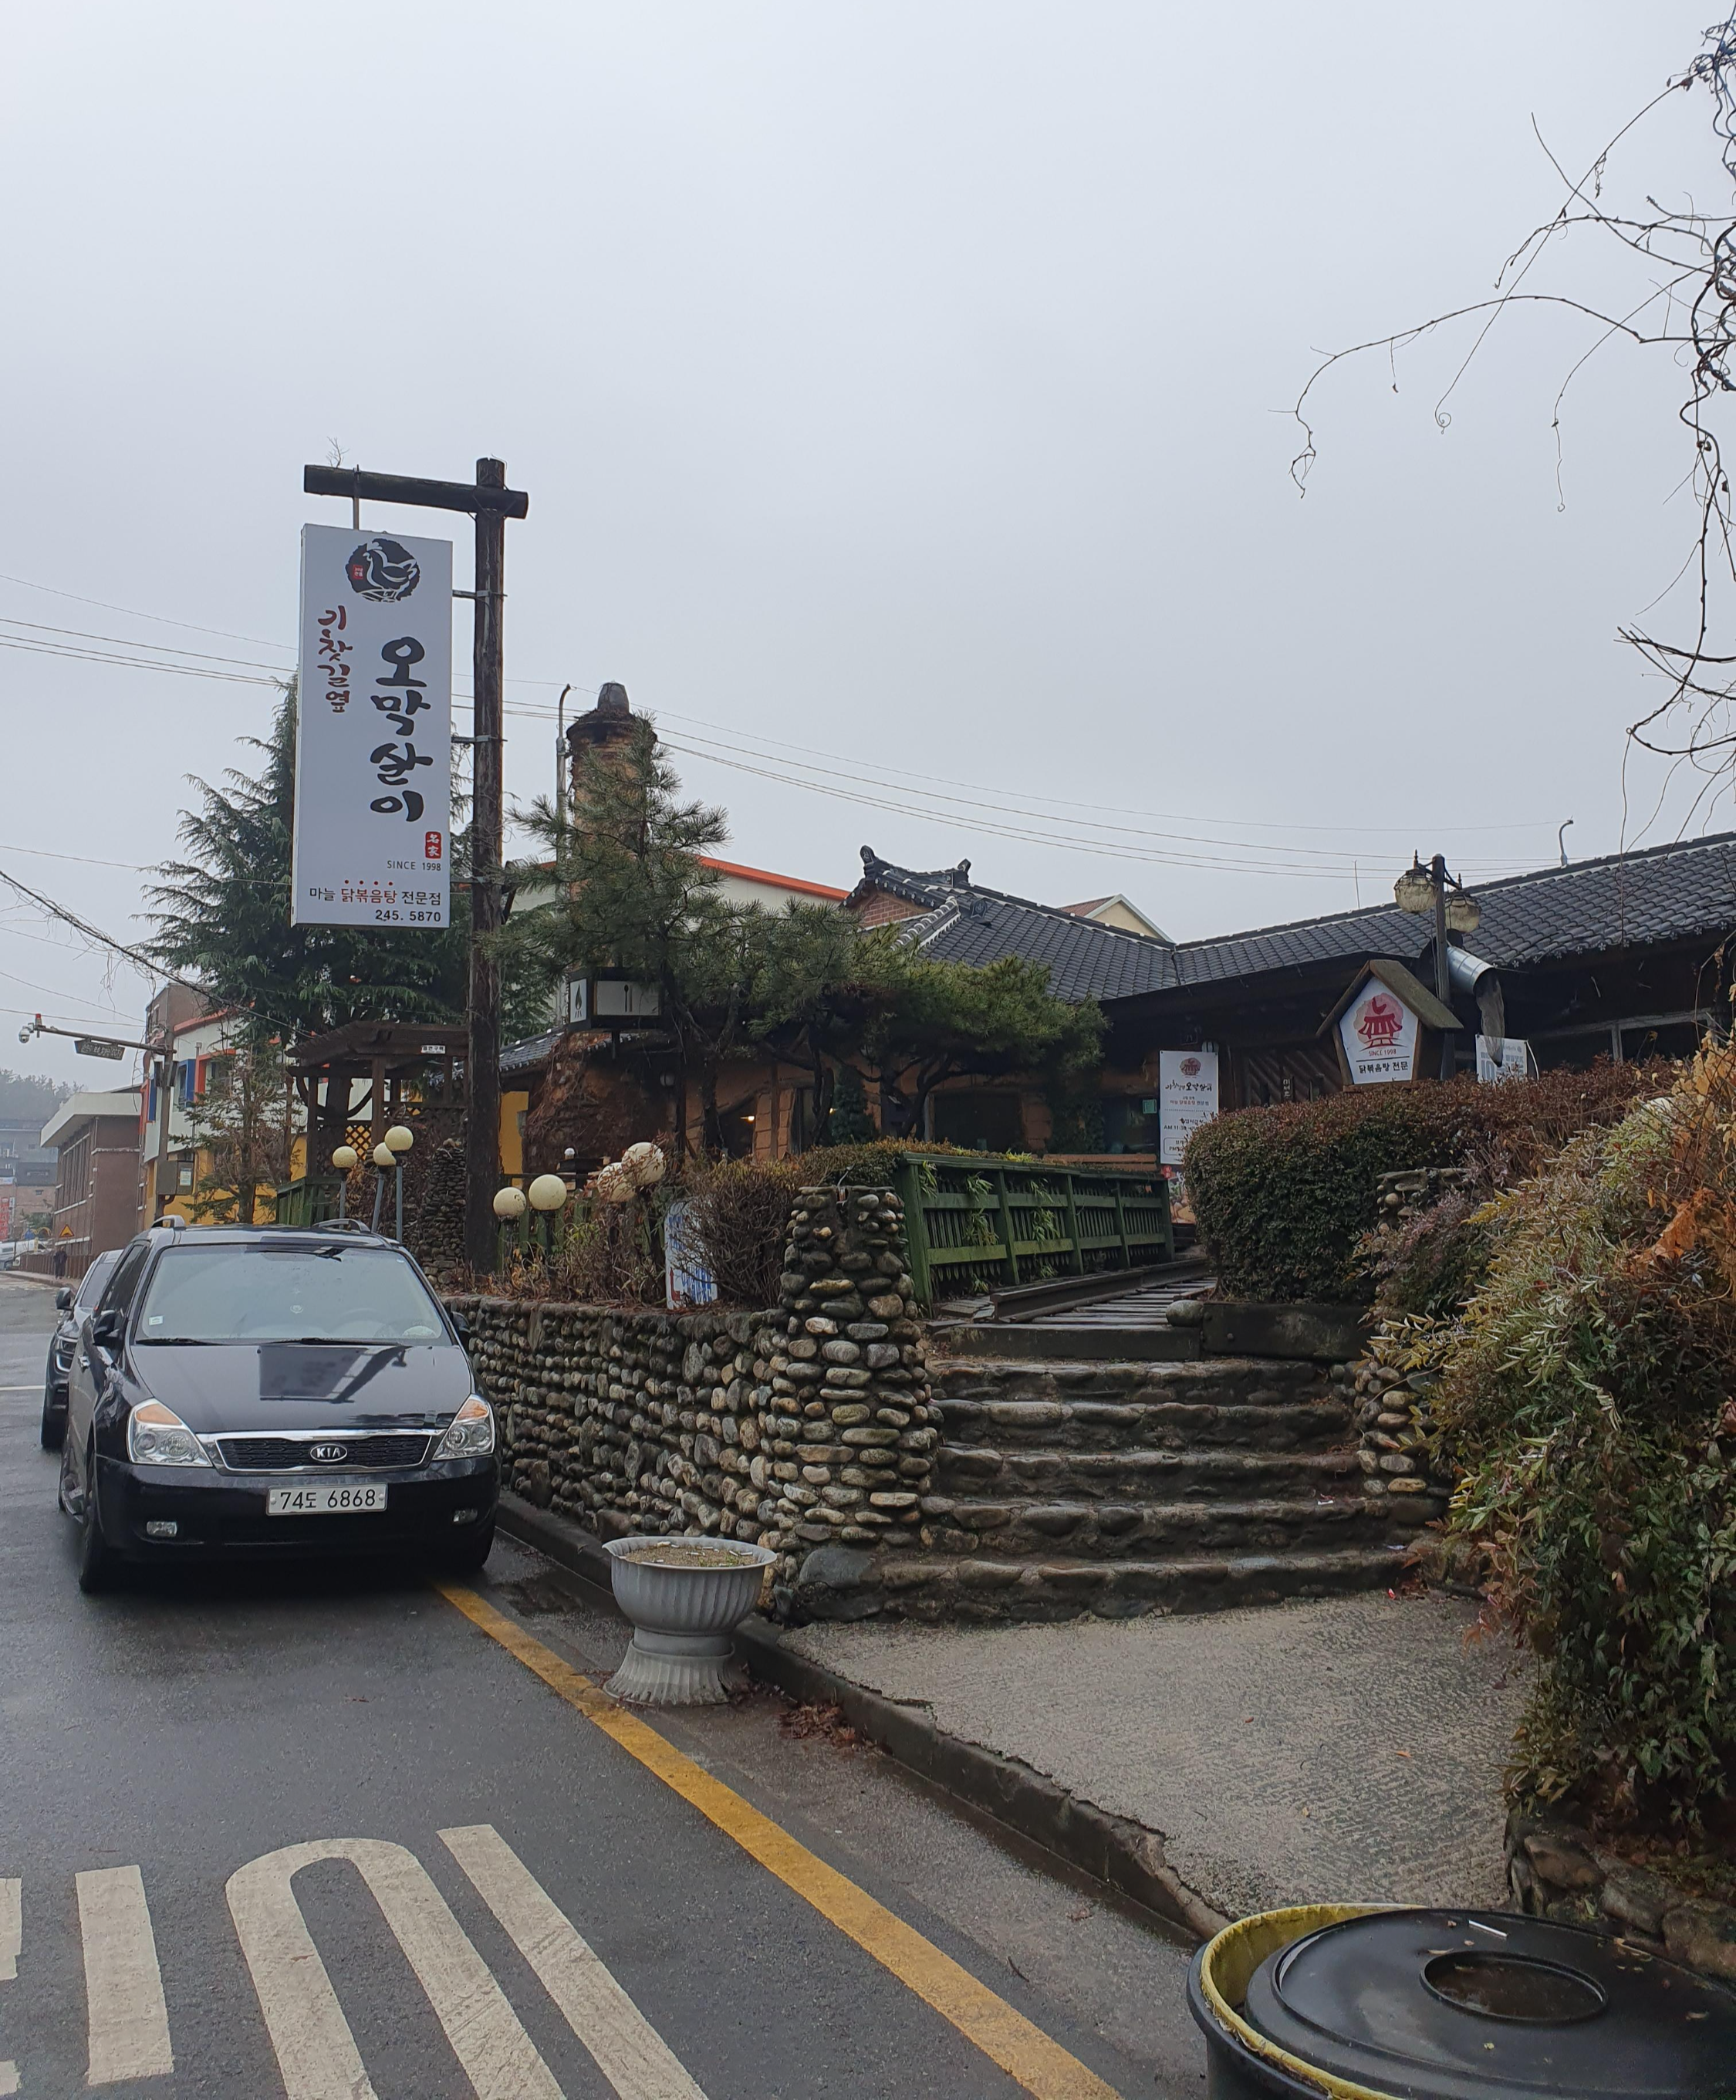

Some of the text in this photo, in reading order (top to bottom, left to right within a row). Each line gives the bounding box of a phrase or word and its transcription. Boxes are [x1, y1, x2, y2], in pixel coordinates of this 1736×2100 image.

[316, 605, 353, 713] 기찻길옆
[370, 636, 434, 823] 오막살이
[387, 860, 441, 871] SINCE 1998
[309, 888, 441, 906] 마늘 닭볶음탕 전문점
[1392, 1061, 1409, 1071] 전문
[316, 1446, 341, 1458] KIA
[280, 1489, 376, 1510] 74도 6868
